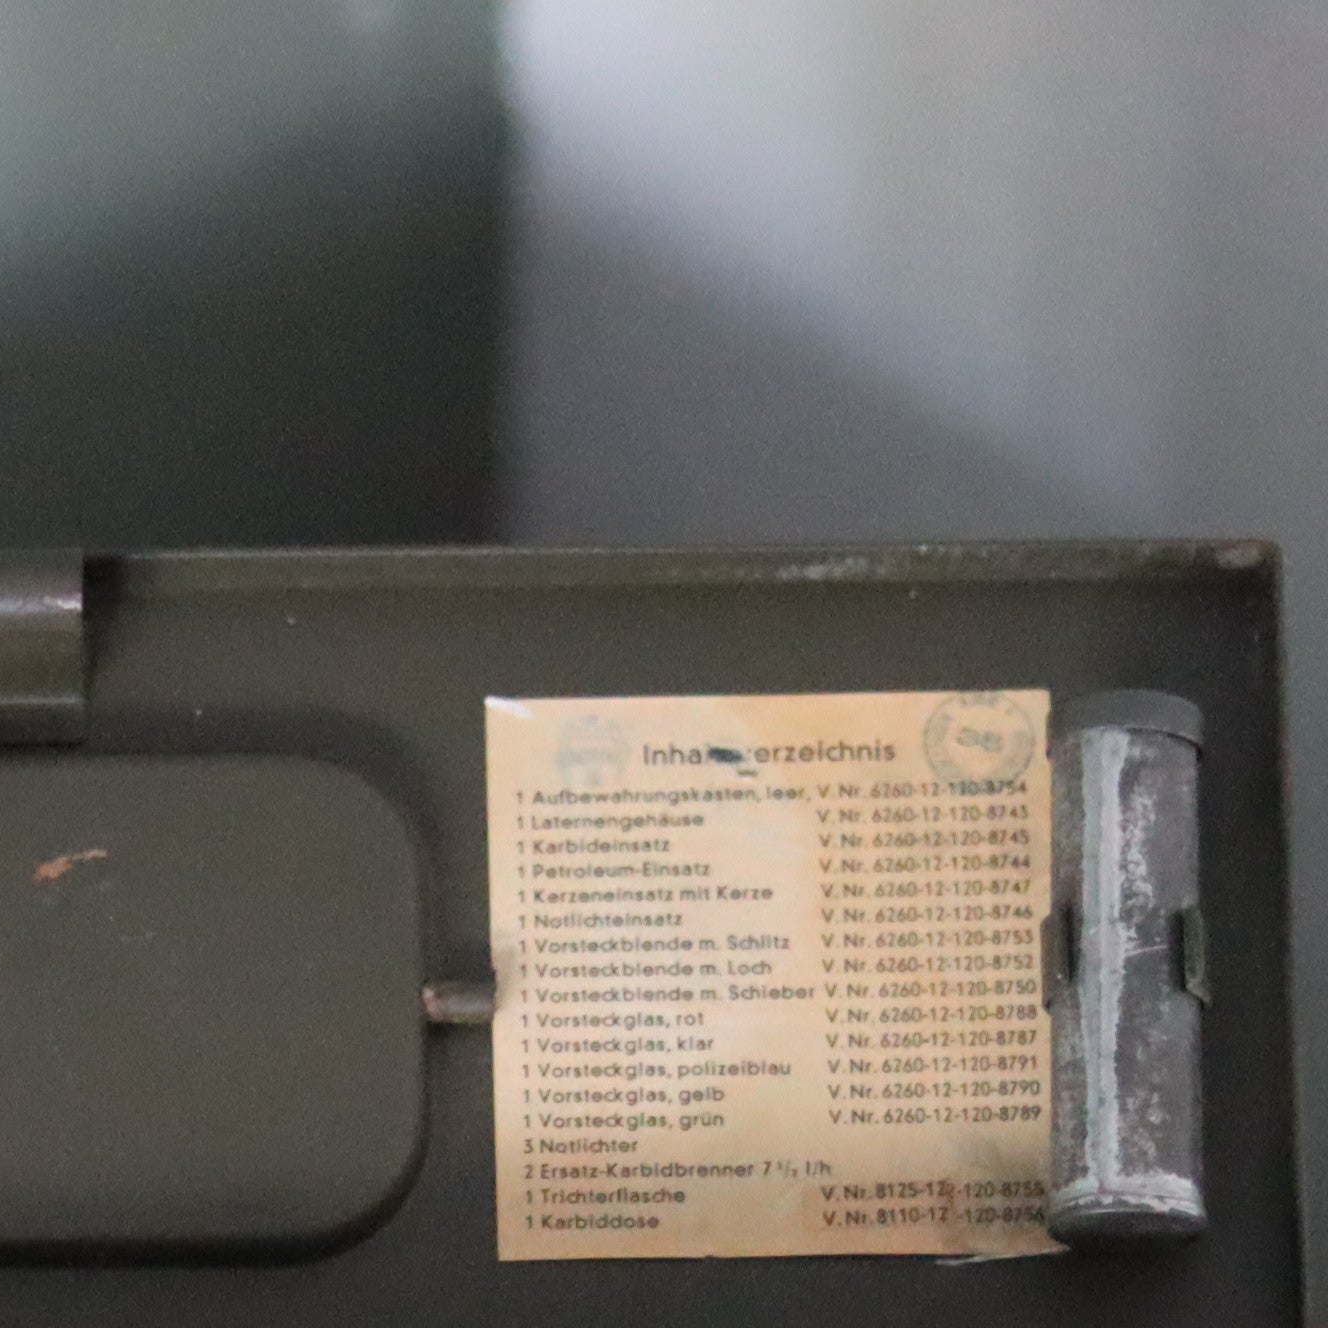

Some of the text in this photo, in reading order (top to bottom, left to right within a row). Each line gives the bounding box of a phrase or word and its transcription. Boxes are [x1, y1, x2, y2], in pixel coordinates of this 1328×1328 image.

[643, 738, 896, 766] Inhaerzeichnis
[533, 787, 761, 806] Aufbewahrungskasten,
[533, 838, 670, 855] Karbideinsatz
[532, 861, 711, 879] Petroleum-Einsatz
[533, 888, 673, 904] Kerzeneinsatz
[679, 886, 710, 901] mit
[716, 885, 773, 901] Kerze
[534, 912, 683, 929] Notlichteinsatz
[534, 935, 692, 954] Vorsteckblende
[727, 934, 790, 950] Schlitz
[535, 960, 693, 979] Vorsteckblende
[727, 959, 772, 975] Loch
[535, 985, 694, 1004] Vorsteckblende
[728, 984, 815, 1001] Schieber
[536, 1012, 670, 1030] Vorsteckglas,
[676, 1013, 705, 1026] rot
[537, 1037, 671, 1056] Vorsteckglas,
[677, 1035, 714, 1051] klar
[538, 1062, 672, 1081] Vorsteckglas,
[677, 1060, 792, 1079] polizeiblau
[538, 1087, 673, 1106] Vorsteckglas,
[678, 1087, 725, 1105] gelb
[539, 1112, 673, 1131] Vorsteckglas,
[679, 1112, 725, 1131] grün
[539, 1138, 638, 1154] Notlichter
[541, 1160, 754, 1179] Ersatz-Karbidbrenner
[763, 1161, 772, 1175] 7
[541, 1187, 686, 1205] Trichterflasche
[541, 1212, 660, 1230] Karbiddose
